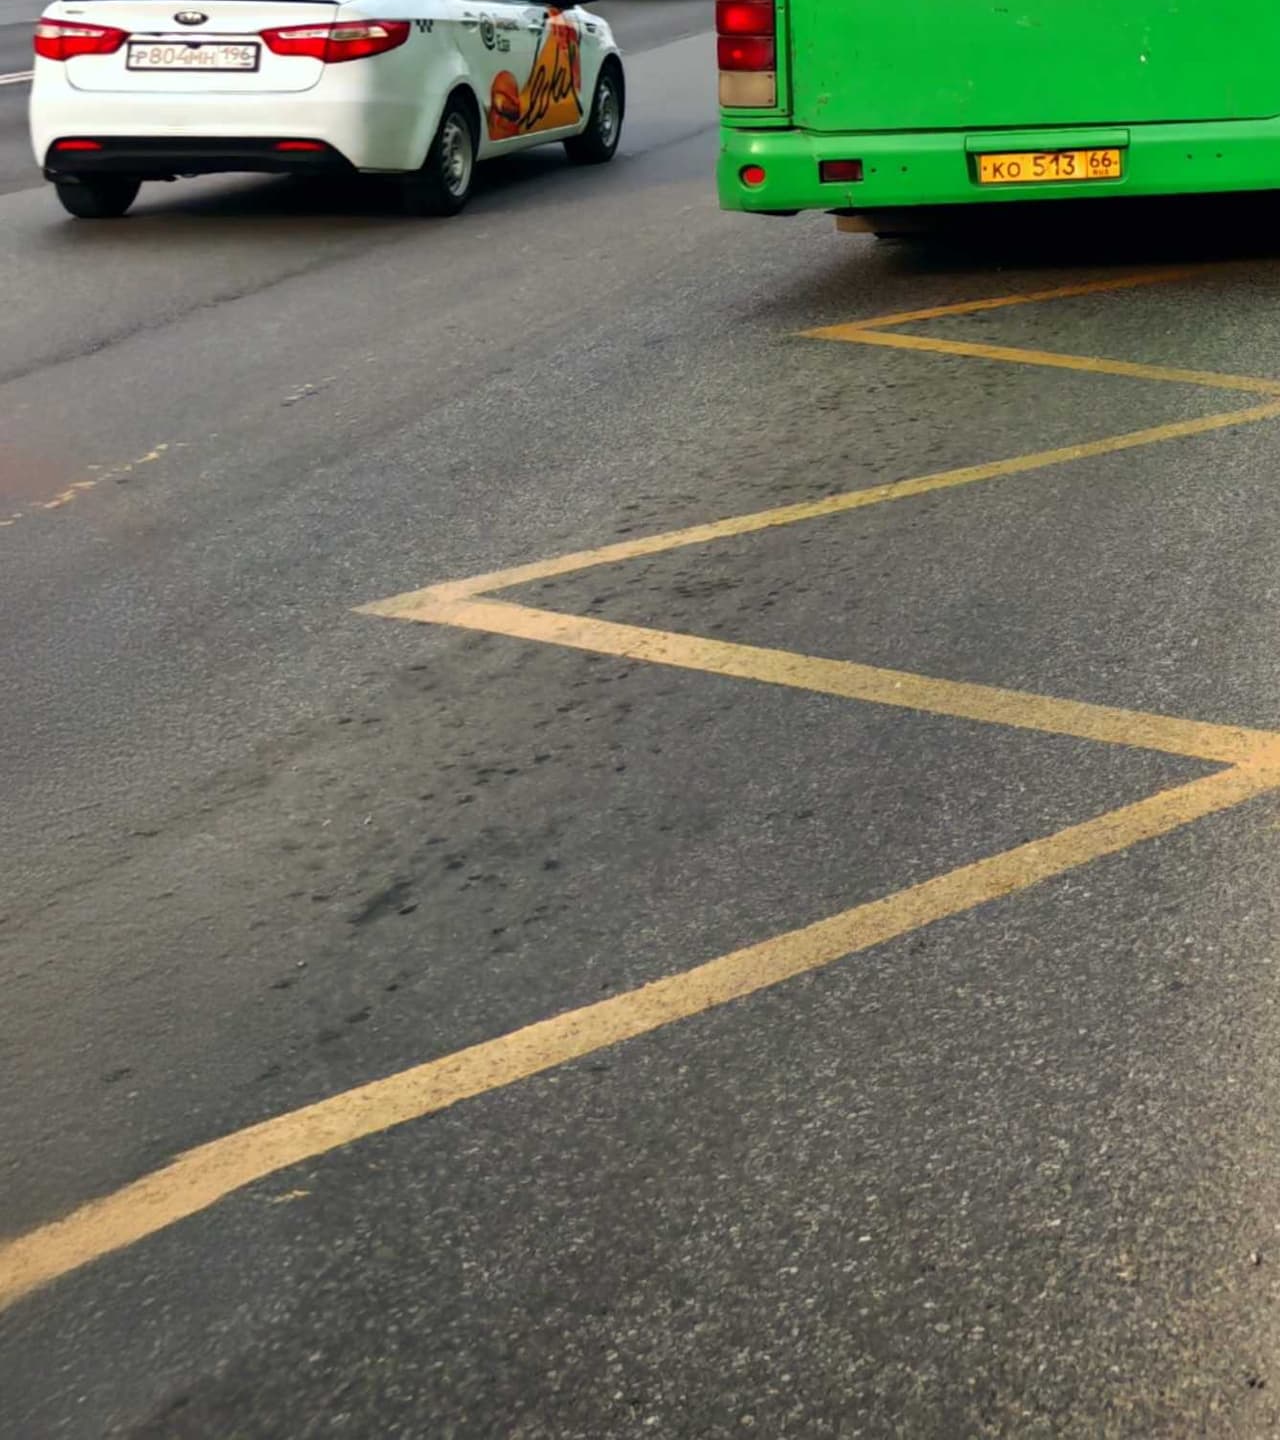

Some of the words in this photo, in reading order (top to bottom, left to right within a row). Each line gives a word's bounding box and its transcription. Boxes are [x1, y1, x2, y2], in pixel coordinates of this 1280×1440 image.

[221, 47, 250, 60] 196
[992, 162, 1021, 178] КО
[1033, 154, 1075, 177] 513
[1089, 152, 1112, 168] 66
